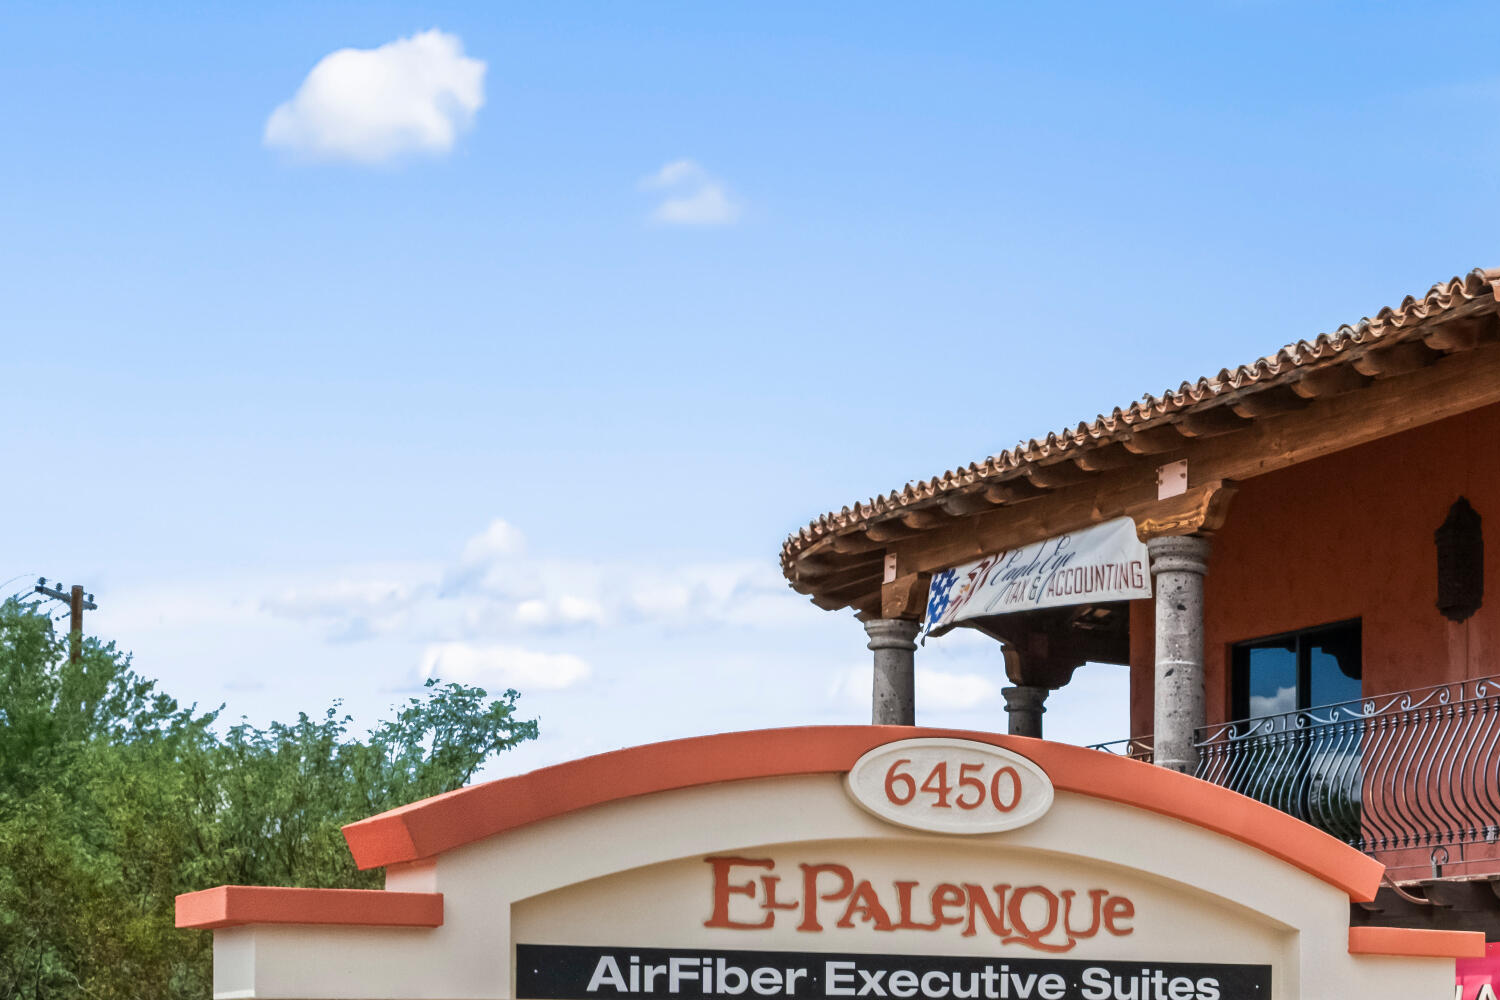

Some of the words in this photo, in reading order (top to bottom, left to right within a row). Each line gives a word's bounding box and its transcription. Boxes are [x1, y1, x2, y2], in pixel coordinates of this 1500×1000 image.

[1005, 579, 1029, 604] TAX
[1046, 561, 1143, 598] ACCOUNTING
[884, 759, 1022, 813] 6450
[586, 955, 808, 996] AirFiber
[825, 960, 1067, 999] Executive
